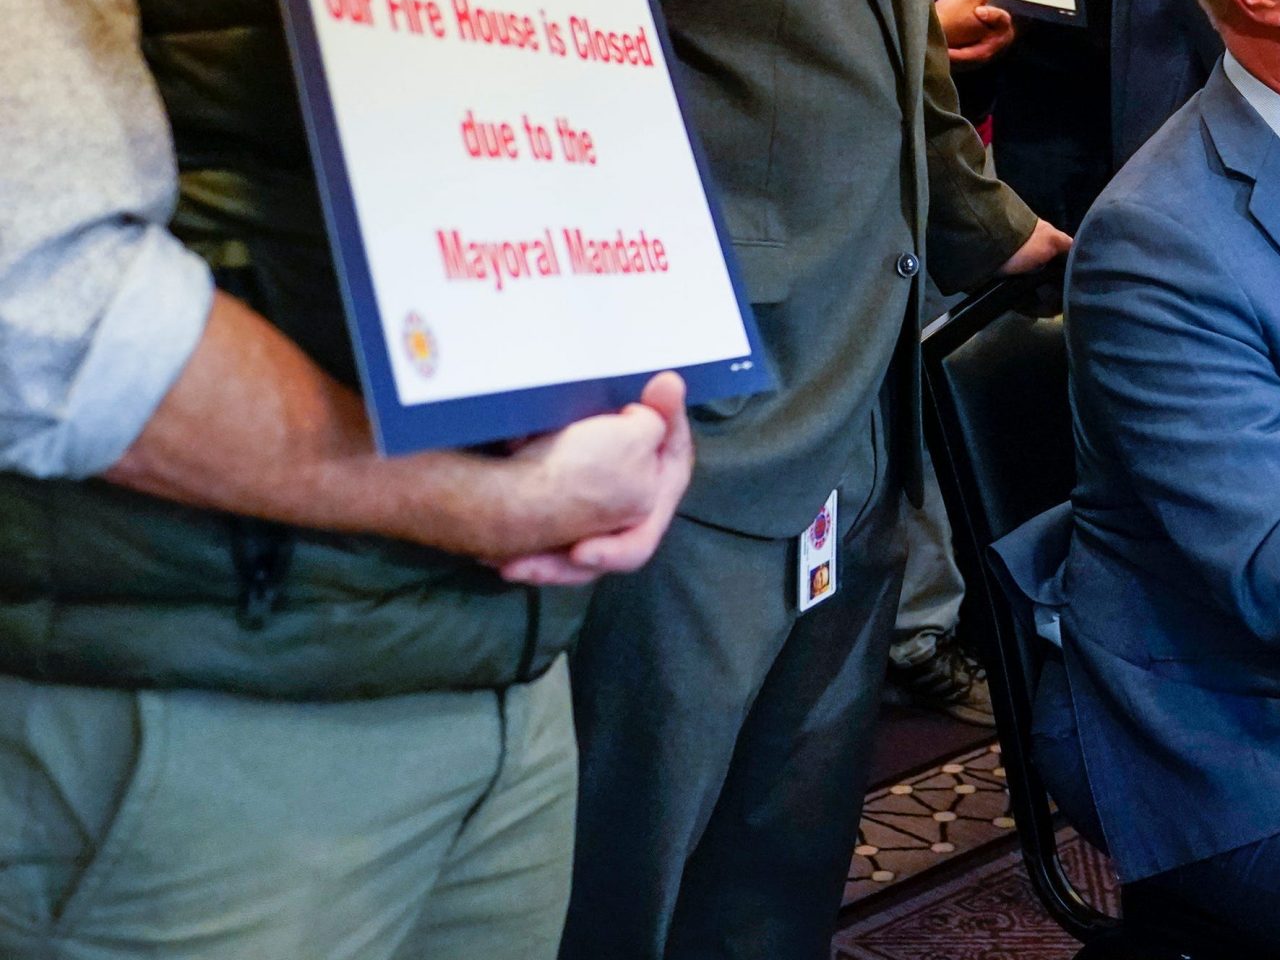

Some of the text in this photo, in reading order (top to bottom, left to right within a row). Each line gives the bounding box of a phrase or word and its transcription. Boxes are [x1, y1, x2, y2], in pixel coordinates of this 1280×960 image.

[539, 9, 567, 56] is
[569, 15, 655, 67] Closed
[461, 110, 597, 166] due to the
[436, 228, 669, 292] Mayoral Mandate
